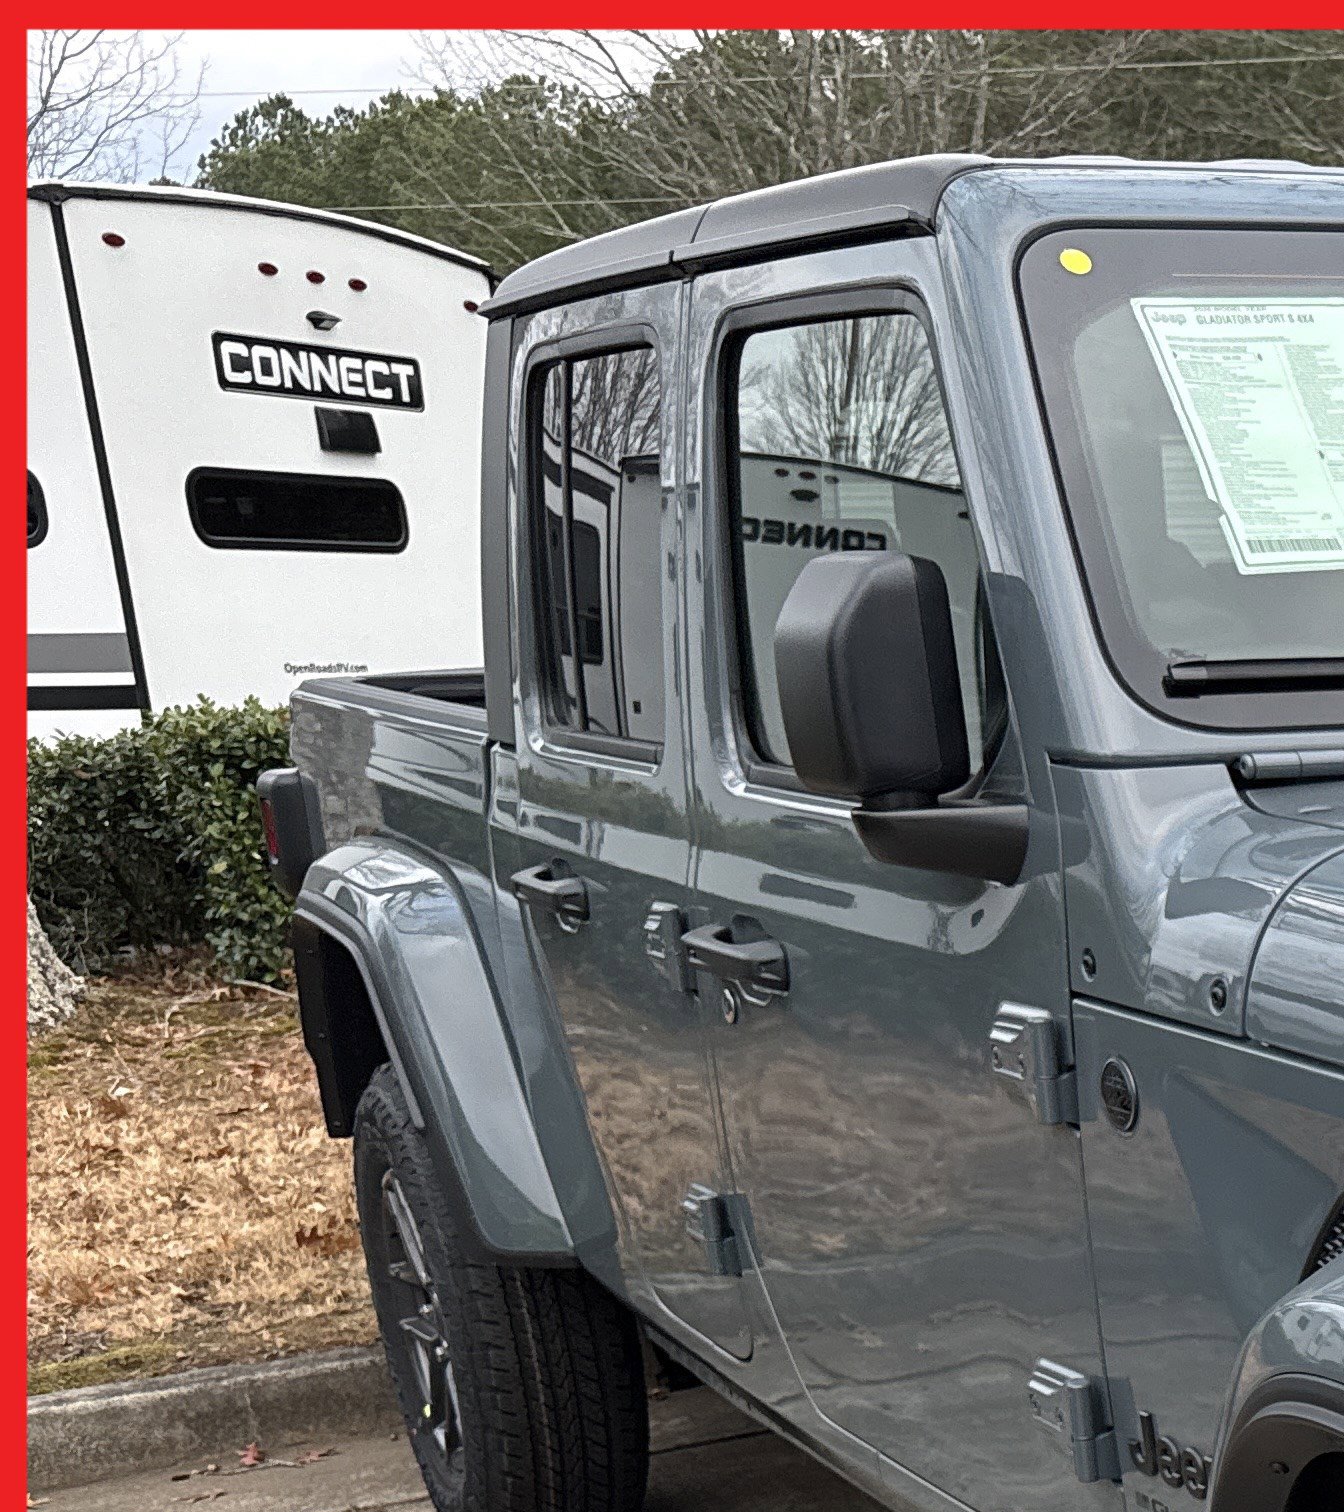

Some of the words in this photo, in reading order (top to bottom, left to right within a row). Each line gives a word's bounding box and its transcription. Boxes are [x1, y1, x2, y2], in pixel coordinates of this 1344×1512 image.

[1152, 312, 1187, 326] Jeep
[1196, 313, 1251, 326] GLADIATOR
[1254, 313, 1286, 325] SPORT
[220, 339, 415, 403] CONNECT
[1128, 1410, 1213, 1501] Jee
